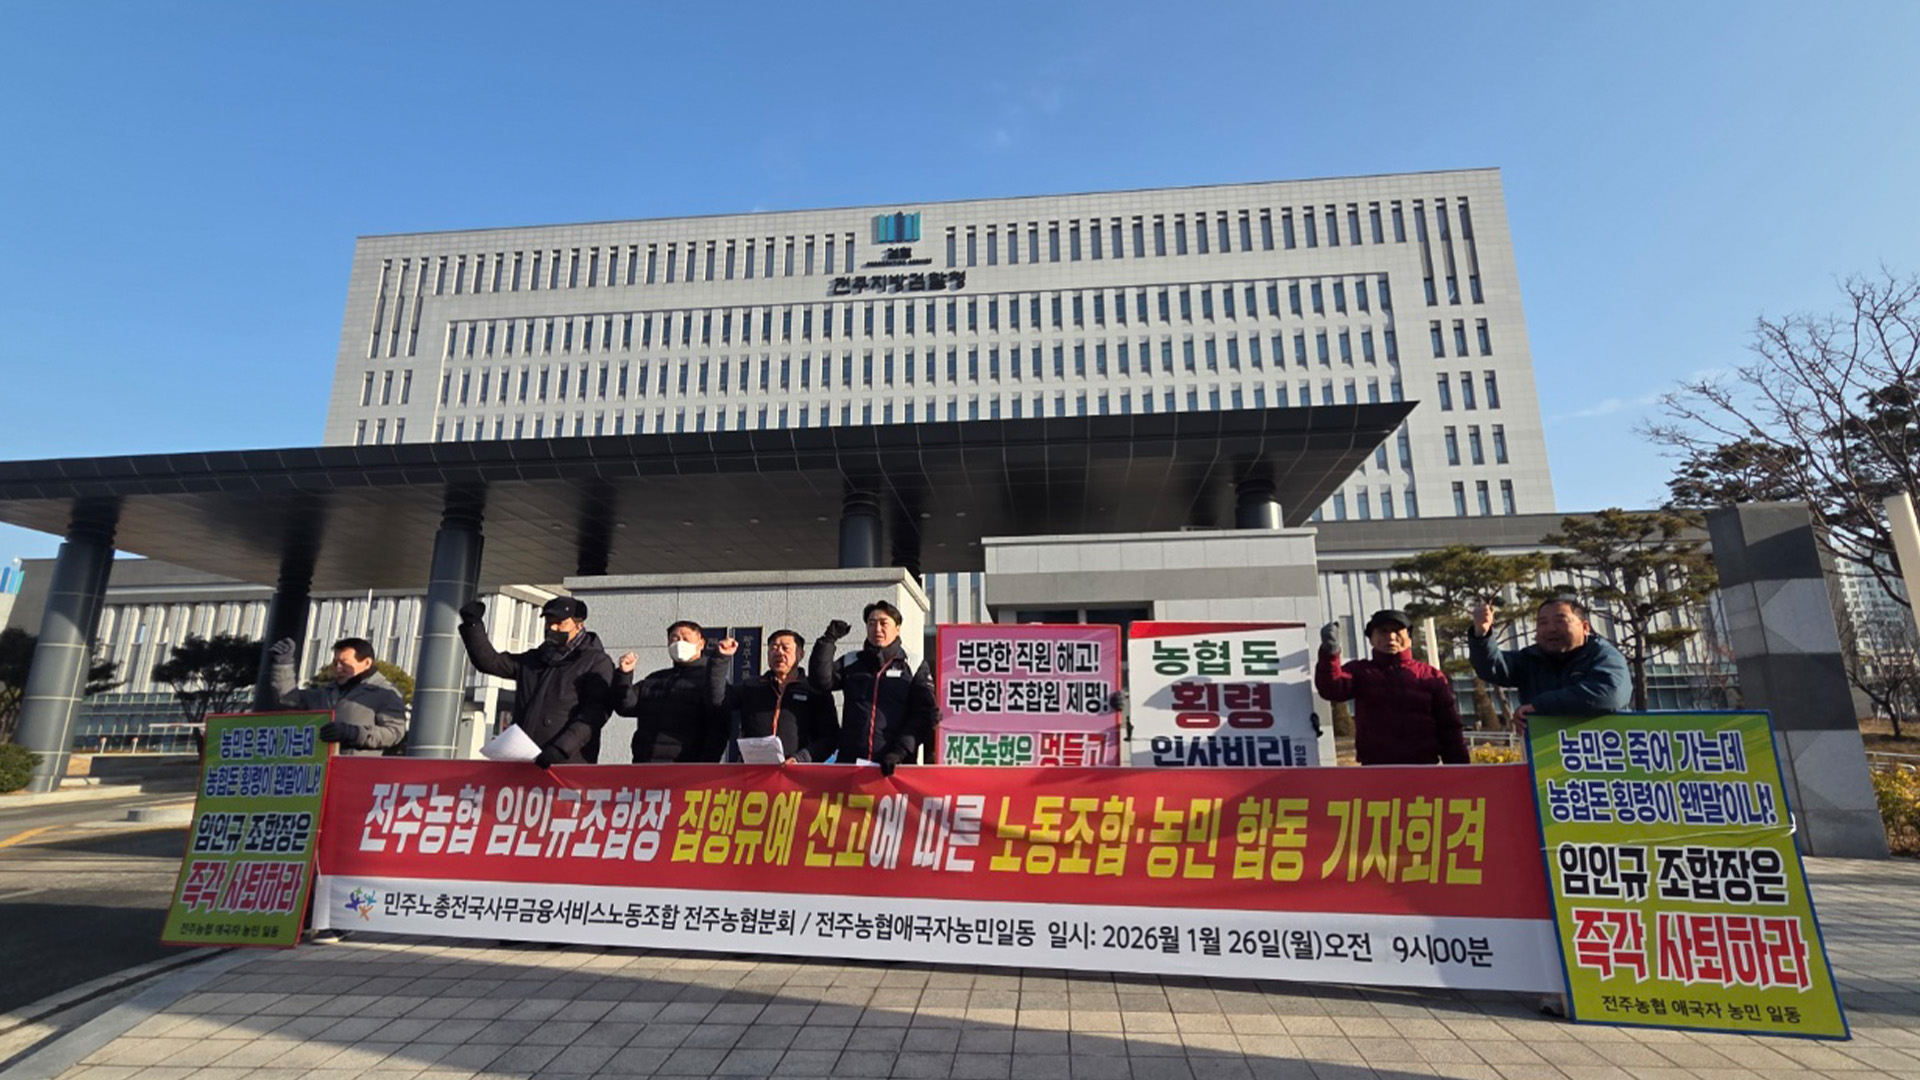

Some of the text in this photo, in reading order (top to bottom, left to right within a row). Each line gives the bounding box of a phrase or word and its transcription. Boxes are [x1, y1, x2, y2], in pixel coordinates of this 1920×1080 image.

[832, 270, 966, 295] 전주지방검찰청
[957, 640, 1099, 674] 부당한 직원 해고!
[1152, 640, 1280, 676] 농협 돈
[947, 680, 1108, 714] 부당한 조합원 제명!
[1171, 682, 1275, 729] 횡령
[220, 727, 315, 758] 농민은 죽어 가는데
[1151, 735, 1294, 767] 인사비리
[1559, 730, 1747, 772] 농민은 죽어 가는데
[204, 764, 239, 796] 농협돈
[240, 764, 272, 796] 횡령이
[1548, 780, 1778, 826] 농협돈 횡령이 왠말이냐!
[193, 812, 312, 854] 임인규 조합장은
[359, 783, 485, 855] 전주농협
[485, 786, 672, 862] 임인규조합장
[670, 787, 803, 867] 집행유예
[804, 790, 909, 870] 선고에
[911, 793, 986, 873] 따른
[1232, 796, 1309, 881] 합동
[1321, 796, 1486, 885] 기자회견
[180, 861, 304, 914] 즉각 사퇴하라
[1558, 842, 1788, 904] 임인규 조합장은
[384, 890, 1493, 968] 민주노총전국사무금융서비스노동조합 전주농협분회 / 전주농협애국자농민일동 일시: 2026월 1월 26일(월)오전 9시00분
[1572, 907, 1813, 993] 즉각 사퇴하라
[1602, 996, 1802, 1023] 전주농협 애국자 농민 일동
